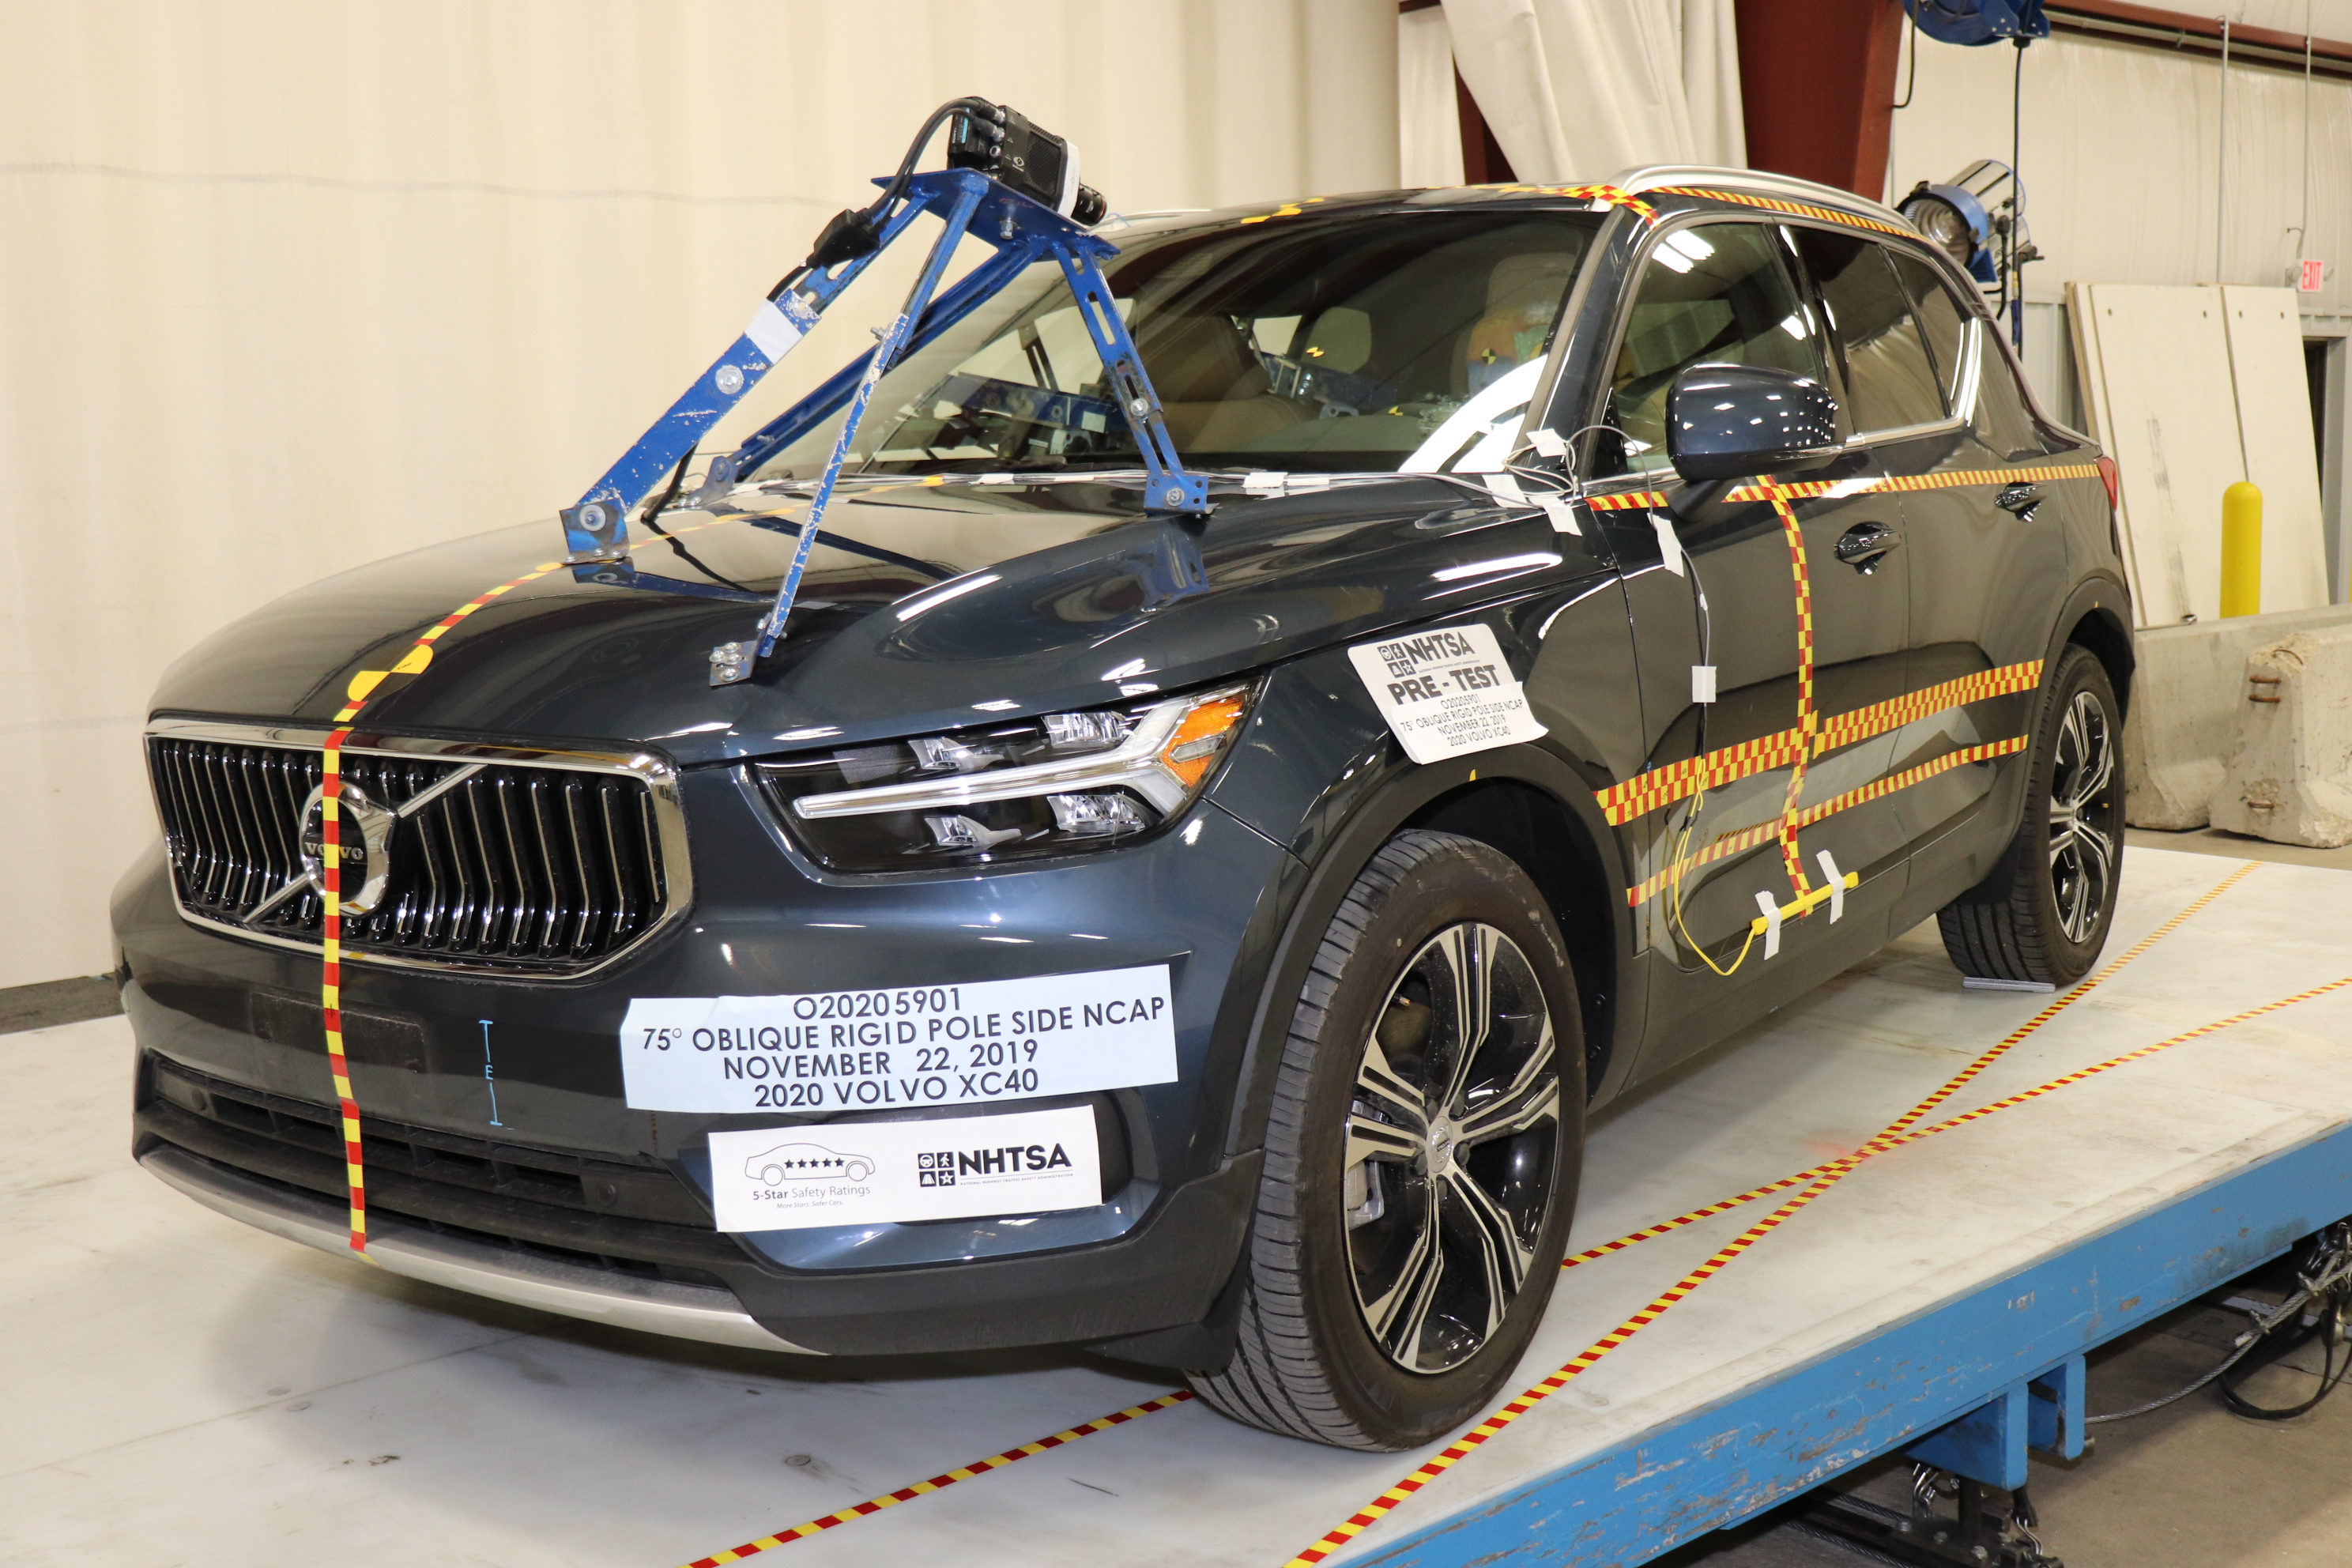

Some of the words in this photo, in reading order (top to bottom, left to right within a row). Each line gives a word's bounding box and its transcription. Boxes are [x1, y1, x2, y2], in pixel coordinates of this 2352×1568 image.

[2302, 261, 2322, 290] EXIT
[1402, 632, 1476, 665] NHTSA
[1387, 675, 1442, 706] PRE
[1449, 664, 1501, 692] TEST
[1415, 711, 1452, 728] OBLIQUE
[1450, 707, 1472, 720] RIGID
[1472, 704, 1491, 716] POLE
[1489, 702, 1505, 713] SIDE
[1503, 699, 1523, 710] NCAP
[1437, 718, 1480, 736] NOVEMBER
[1491, 714, 1506, 726] 2019
[1447, 734, 1467, 747] 2020
[1465, 729, 1493, 742] VOLVO
[1492, 726, 1511, 737] XC40
[304, 842, 364, 861] VOVO
[692, 1025, 819, 1052] OBLIQUE
[831, 1021, 916, 1048] RIGID
[929, 1013, 1001, 1042] POLE
[1012, 1006, 1072, 1035] SIDE
[1084, 997, 1164, 1027] NCAP
[724, 1051, 891, 1080] NOVEMBER
[916, 1046, 959, 1073] 22,
[970, 1038, 1038, 1068] 2019
[755, 1083, 824, 1107] 2020
[833, 1076, 947, 1105] VOLVO
[959, 1068, 1038, 1098] XC40
[958, 1143, 1072, 1176] NHTSA
[753, 1189, 789, 1200] 5-Star
[791, 1186, 827, 1199] Safety
[829, 1185, 871, 1197] Ratings
